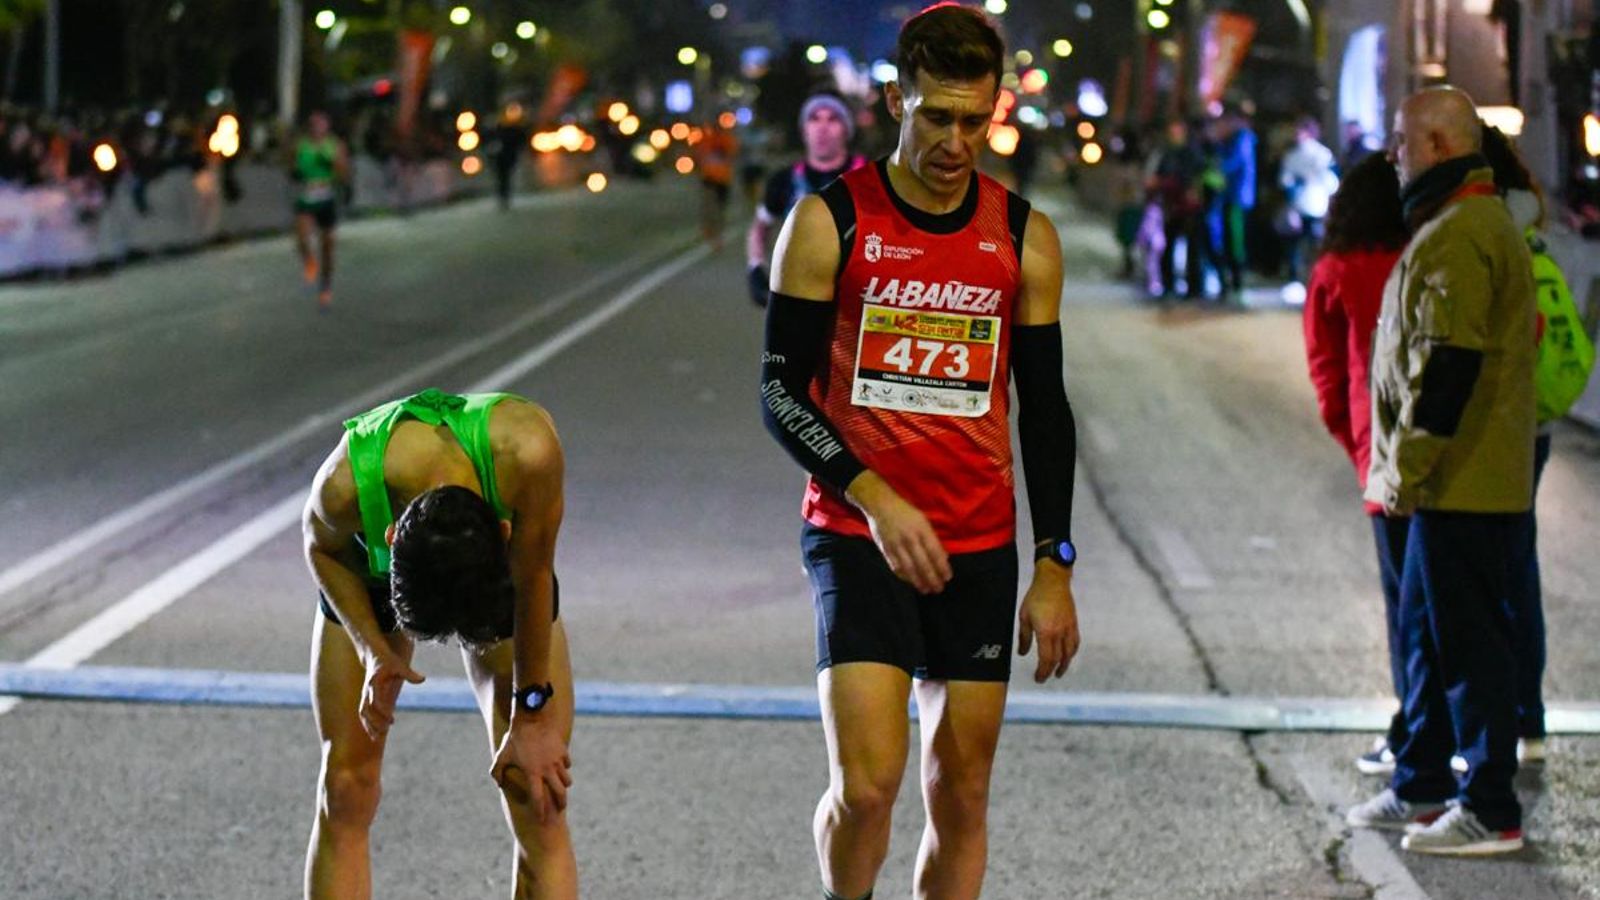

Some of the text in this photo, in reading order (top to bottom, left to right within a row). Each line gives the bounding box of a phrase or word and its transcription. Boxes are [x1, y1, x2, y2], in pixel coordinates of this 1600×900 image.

[883, 337, 970, 379] 473
[761, 379, 843, 462] INTER CAMPUS
